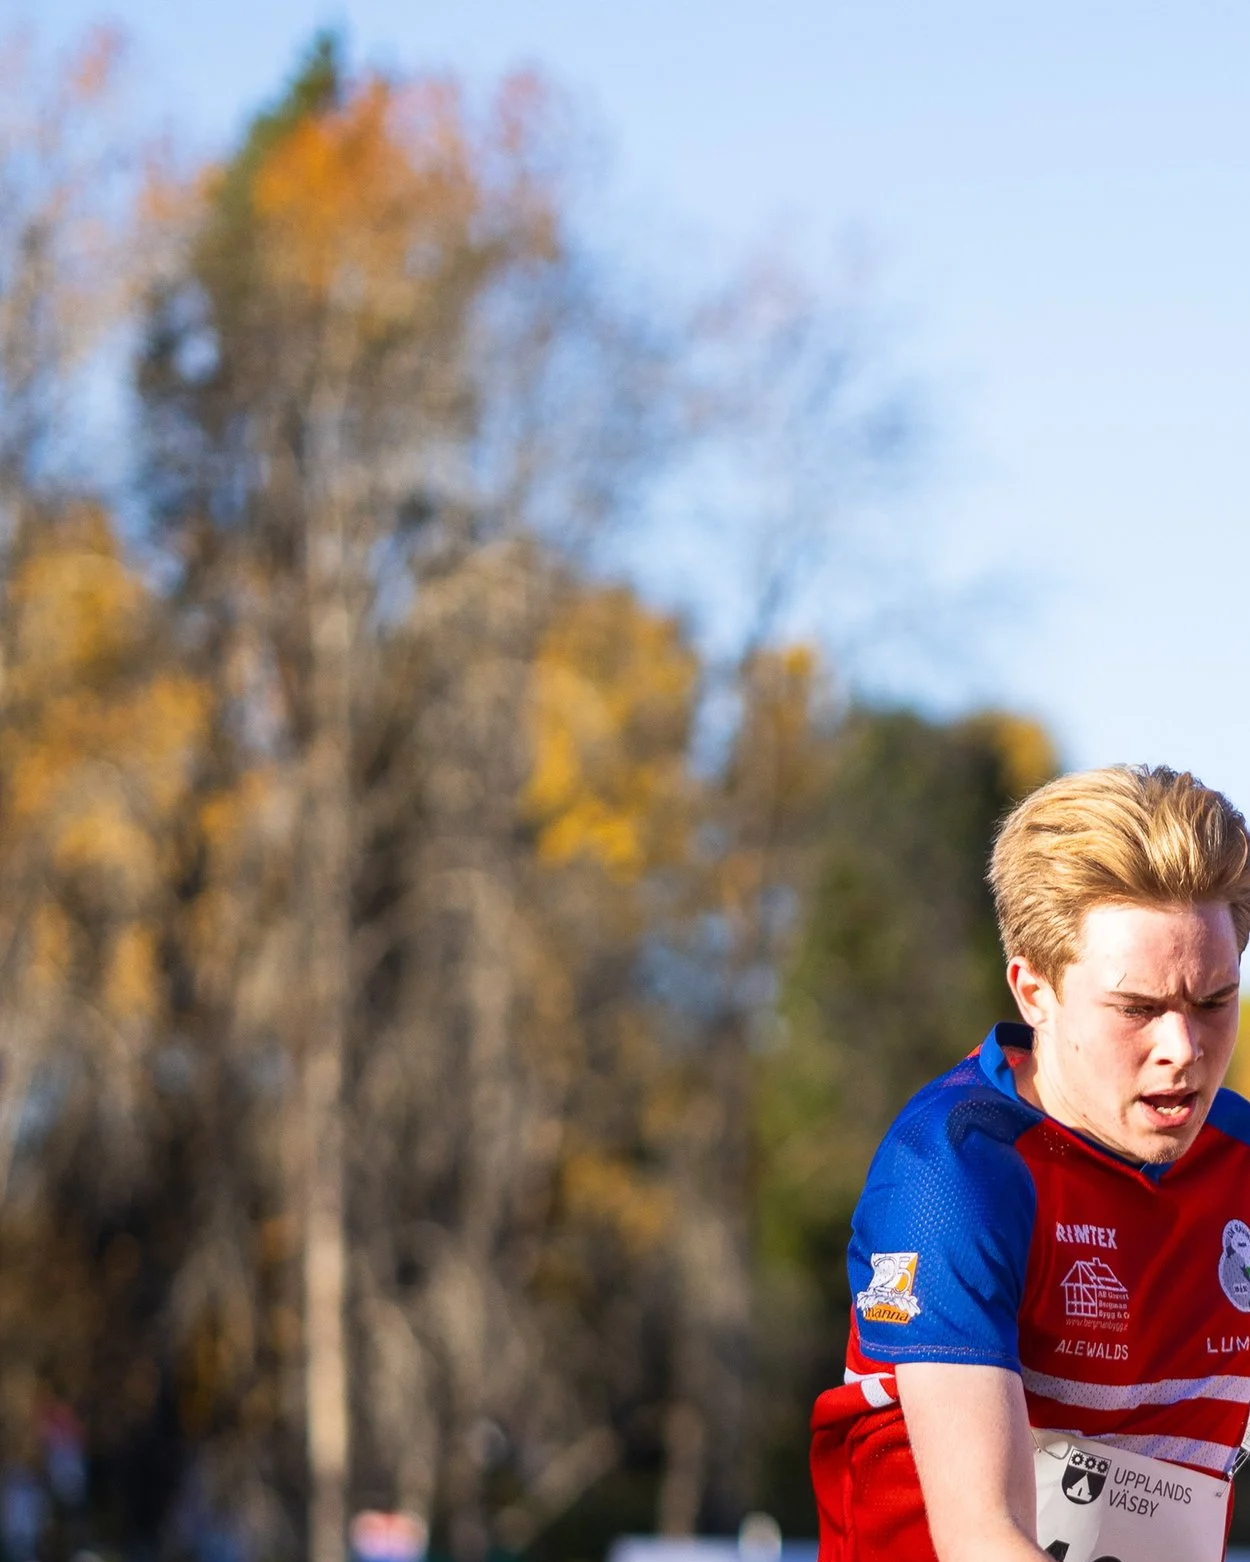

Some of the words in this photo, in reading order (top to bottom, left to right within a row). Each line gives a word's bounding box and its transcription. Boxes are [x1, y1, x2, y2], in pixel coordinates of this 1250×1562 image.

[873, 1256, 912, 1294] 25
[1054, 1339, 1129, 1360] ALEWALDS
[1114, 1467, 1192, 1504] UPPLANDS
[1109, 1489, 1159, 1517] VÄSBY
